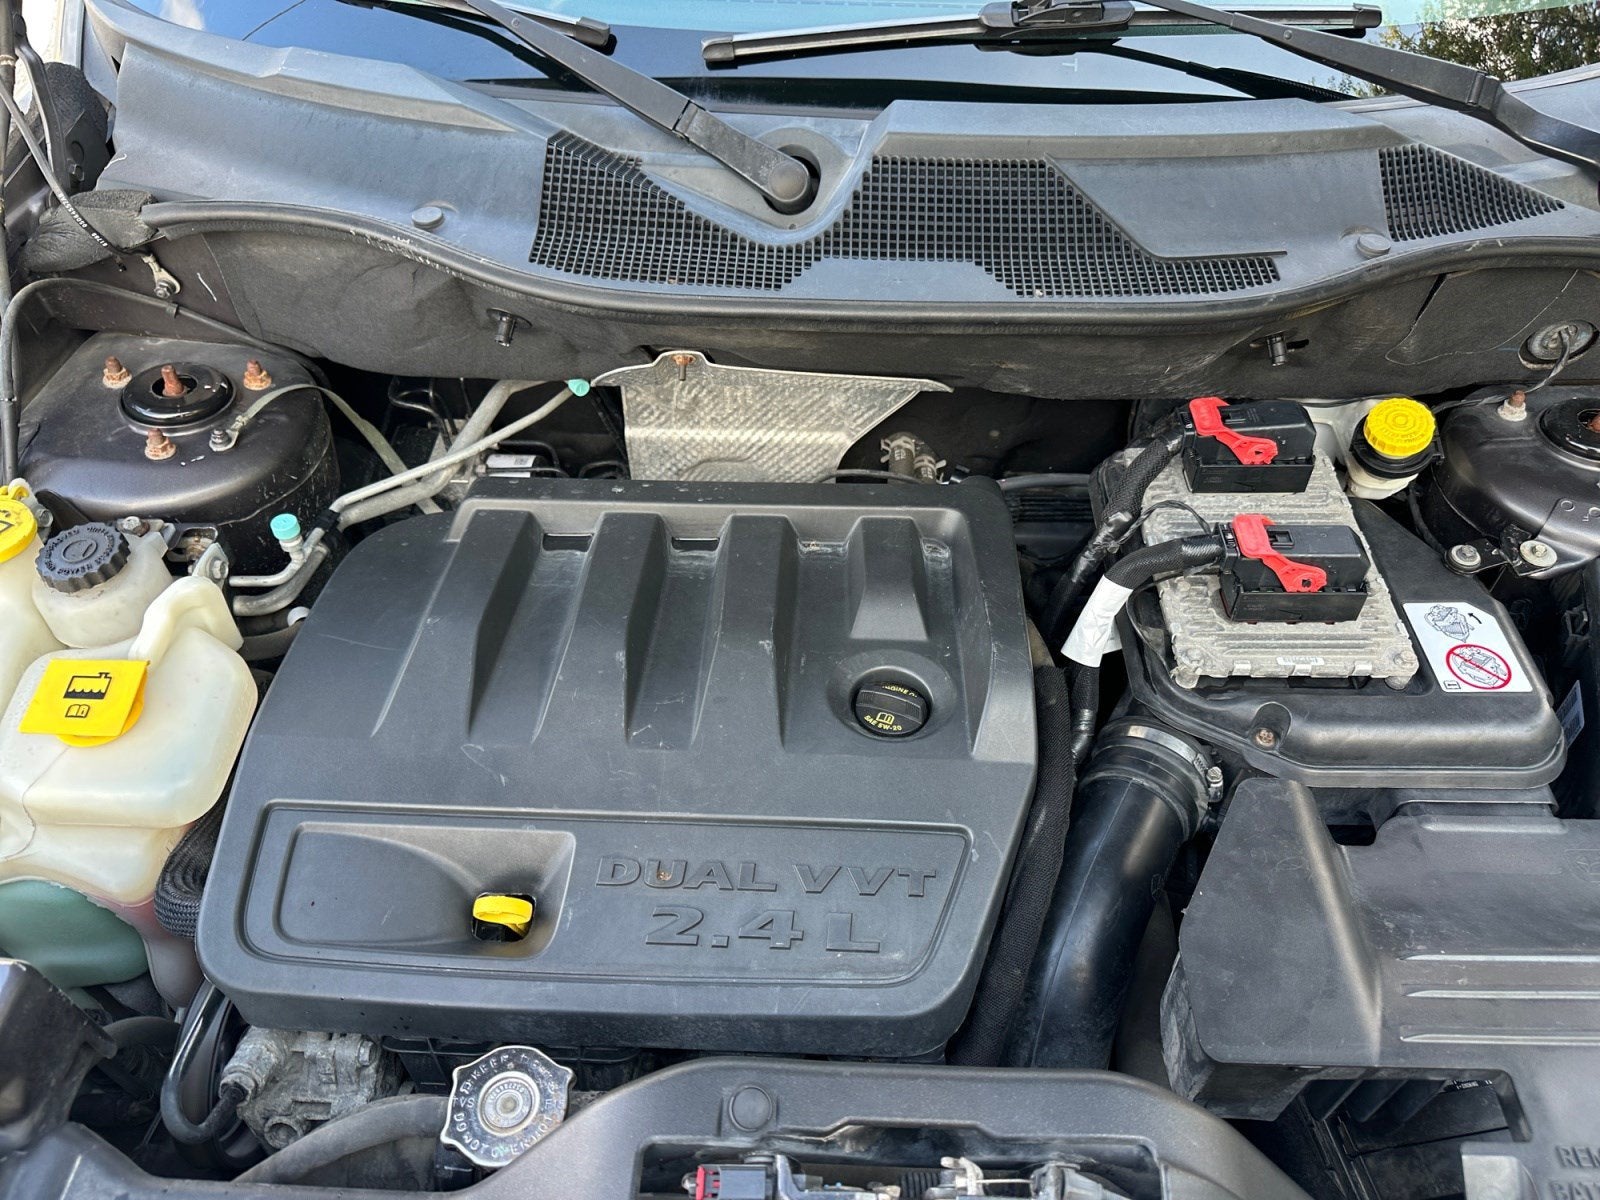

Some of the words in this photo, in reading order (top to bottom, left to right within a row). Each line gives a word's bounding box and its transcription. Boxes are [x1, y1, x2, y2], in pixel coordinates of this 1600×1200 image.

[882, 685, 909, 694] GINE
[864, 715, 877, 726] SAE
[878, 722, 902, 731] 5W-20
[595, 855, 777, 892] DUAL
[792, 864, 937, 898] VVT
[645, 905, 804, 950] 2.4
[826, 912, 880, 953] L
[453, 1112, 467, 1132] DO
[463, 1132, 489, 1153] NOT
